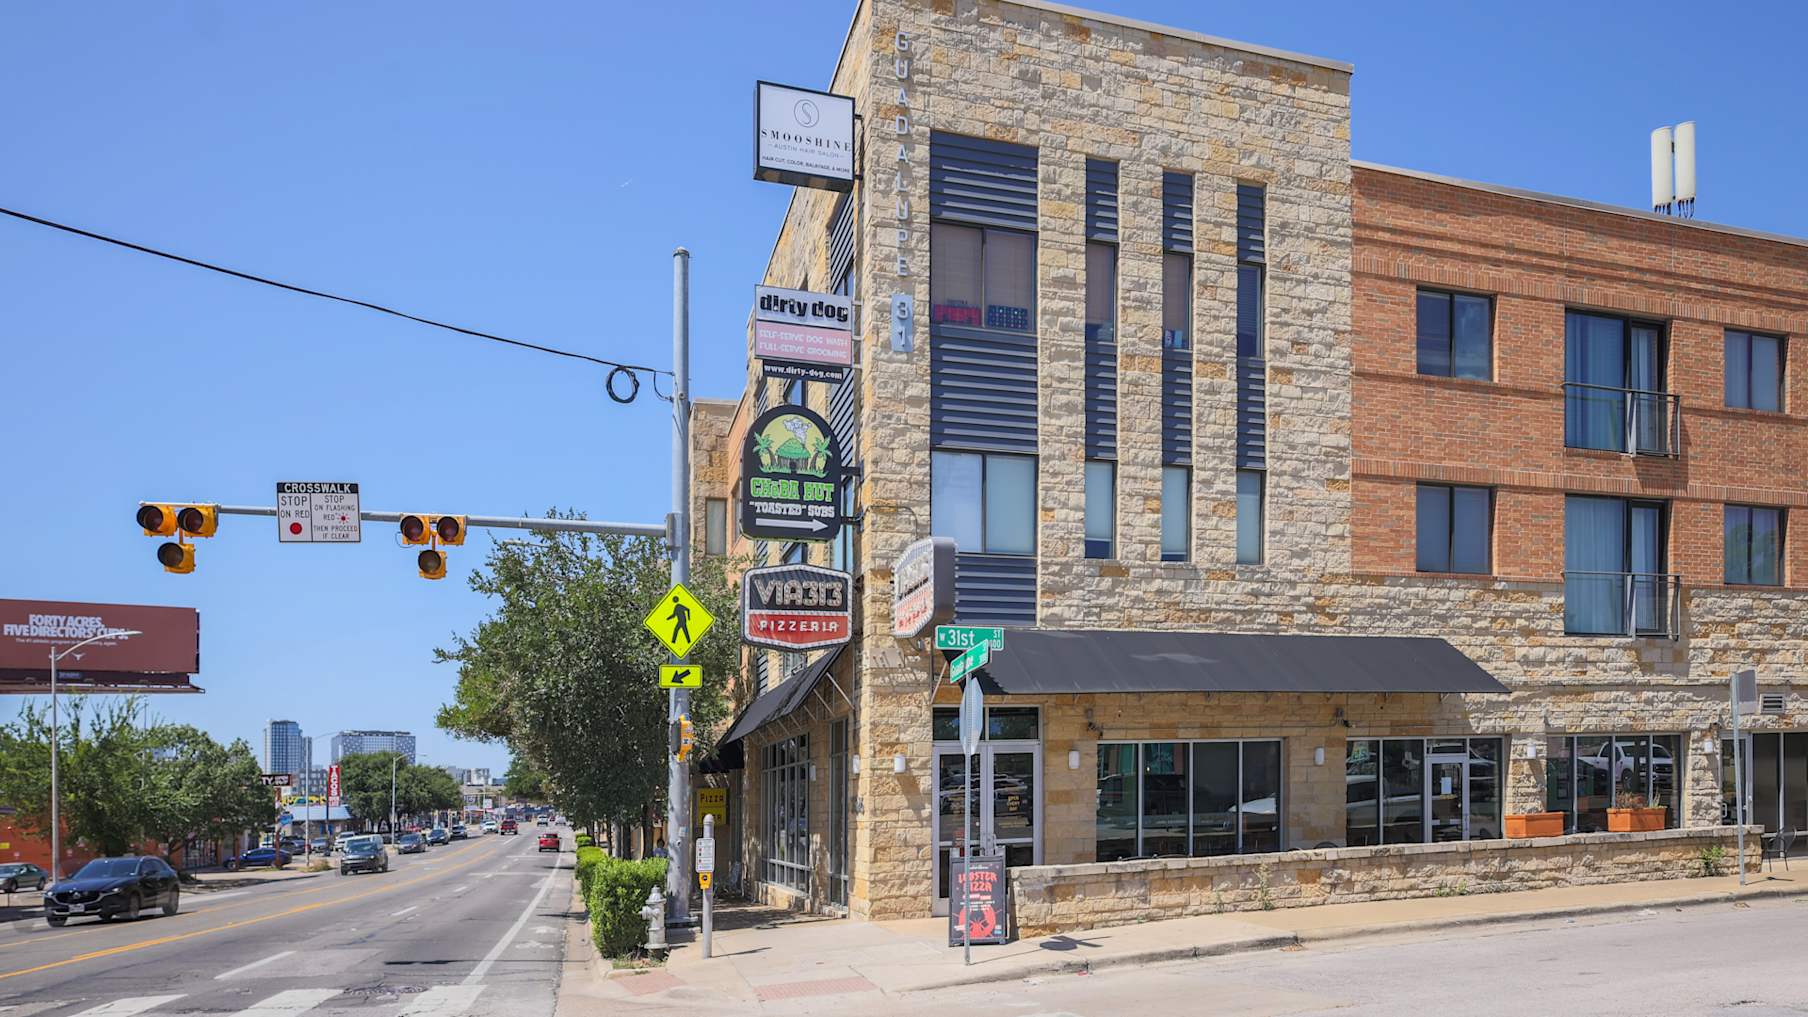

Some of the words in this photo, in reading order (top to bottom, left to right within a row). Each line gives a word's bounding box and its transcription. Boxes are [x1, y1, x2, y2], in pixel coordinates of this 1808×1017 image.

[761, 129, 851, 152] SMOOSHINE
[774, 143, 797, 151] AUSTIN
[895, 31, 909, 278] GUADALUPE
[760, 294, 807, 317] dirty
[811, 301, 848, 322] dog
[760, 329, 804, 342] SELF-SERVE
[806, 335, 823, 344] DOG
[826, 336, 848, 346] WASH
[764, 364, 842, 380] www.dirty-dog.com
[284, 483, 351, 493] CROSSWALK
[803, 481, 835, 502] HUT
[281, 495, 308, 506] STOP
[324, 495, 344, 503] STOP
[280, 510, 291, 518] ON
[295, 510, 310, 519] RED
[807, 504, 835, 518] SUBS
[29, 614, 65, 627] FORTY
[67, 615, 105, 629] ACRES,
[759, 619, 838, 632] PIZZERIA
[3, 624, 30, 636] FIVE
[30, 625, 96, 639] DIRECTORS'
[939, 632, 946, 641] W
[948, 629, 975, 646] 31st
[993, 629, 1001, 638] ST
[330, 765, 338, 797] TACOS
[700, 792, 724, 803] PIZZA
